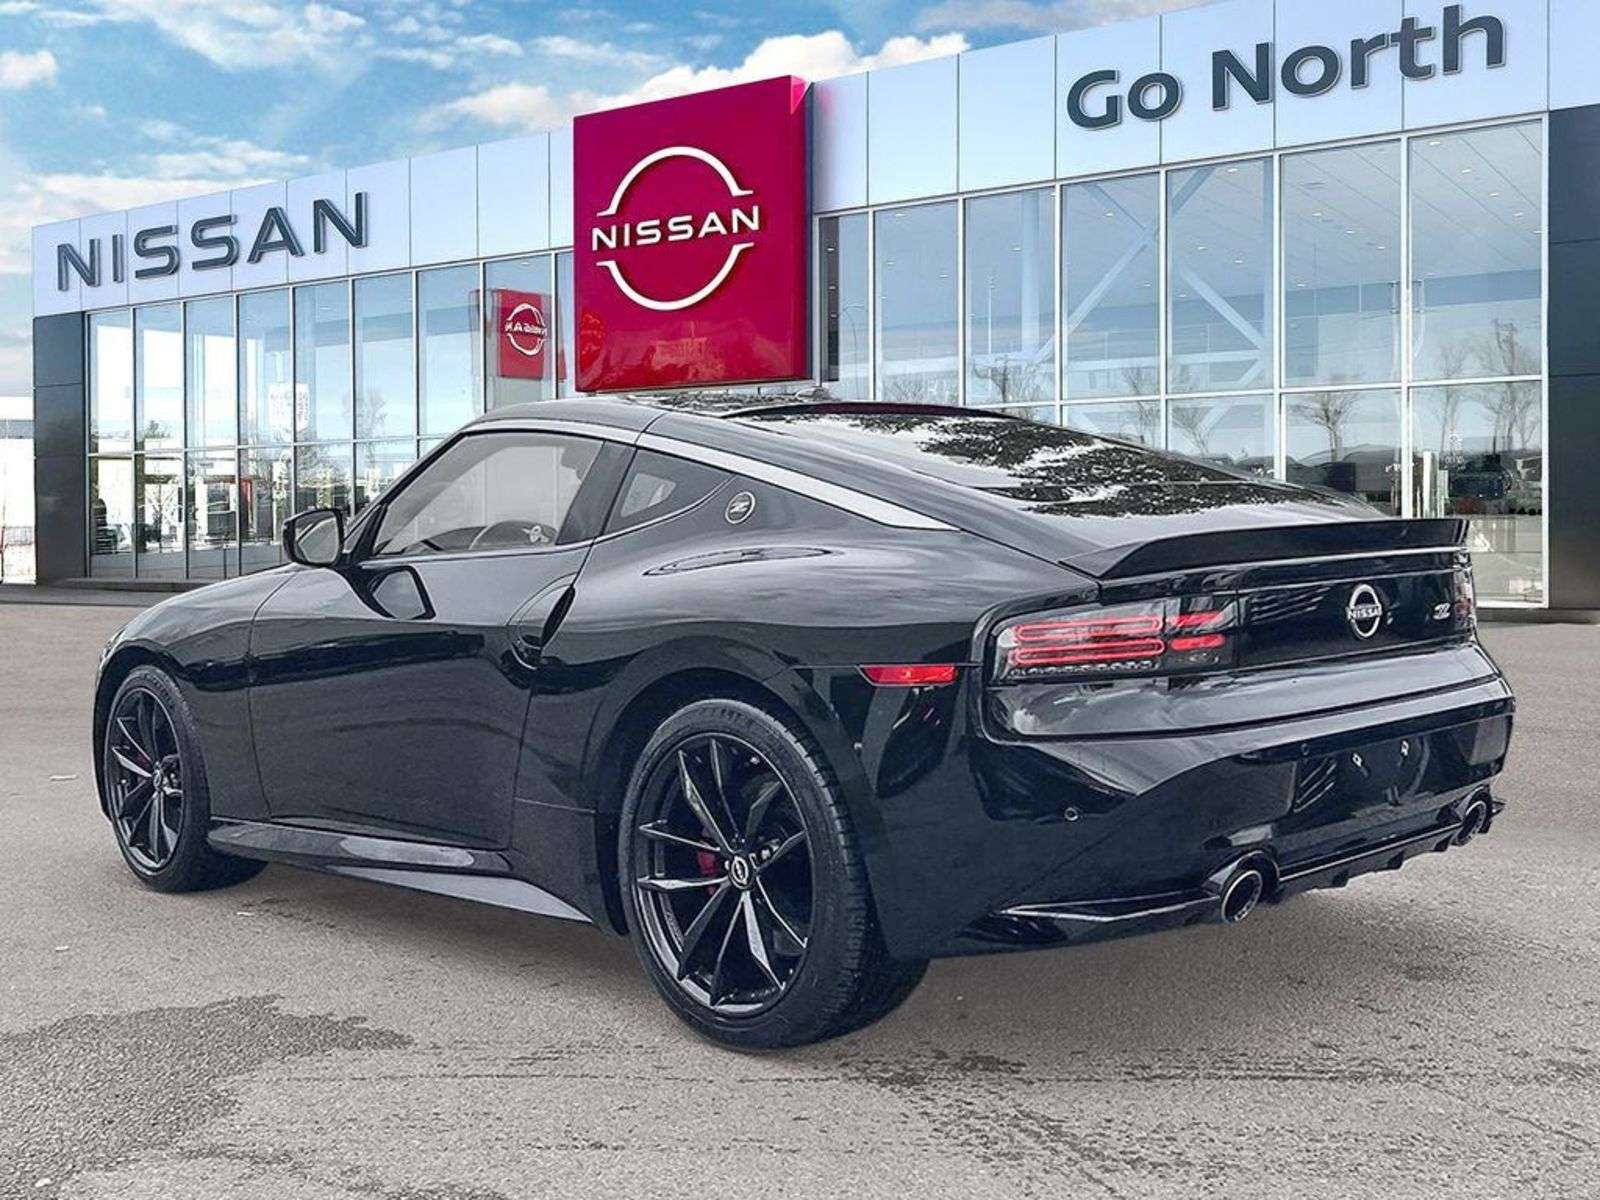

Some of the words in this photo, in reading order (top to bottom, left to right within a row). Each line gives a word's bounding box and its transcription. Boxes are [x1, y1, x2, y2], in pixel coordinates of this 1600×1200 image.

[1067, 69, 1184, 130] Go
[1211, 4, 1507, 111] North
[57, 191, 368, 292] NISSAN
[592, 205, 759, 251] NISSAN
